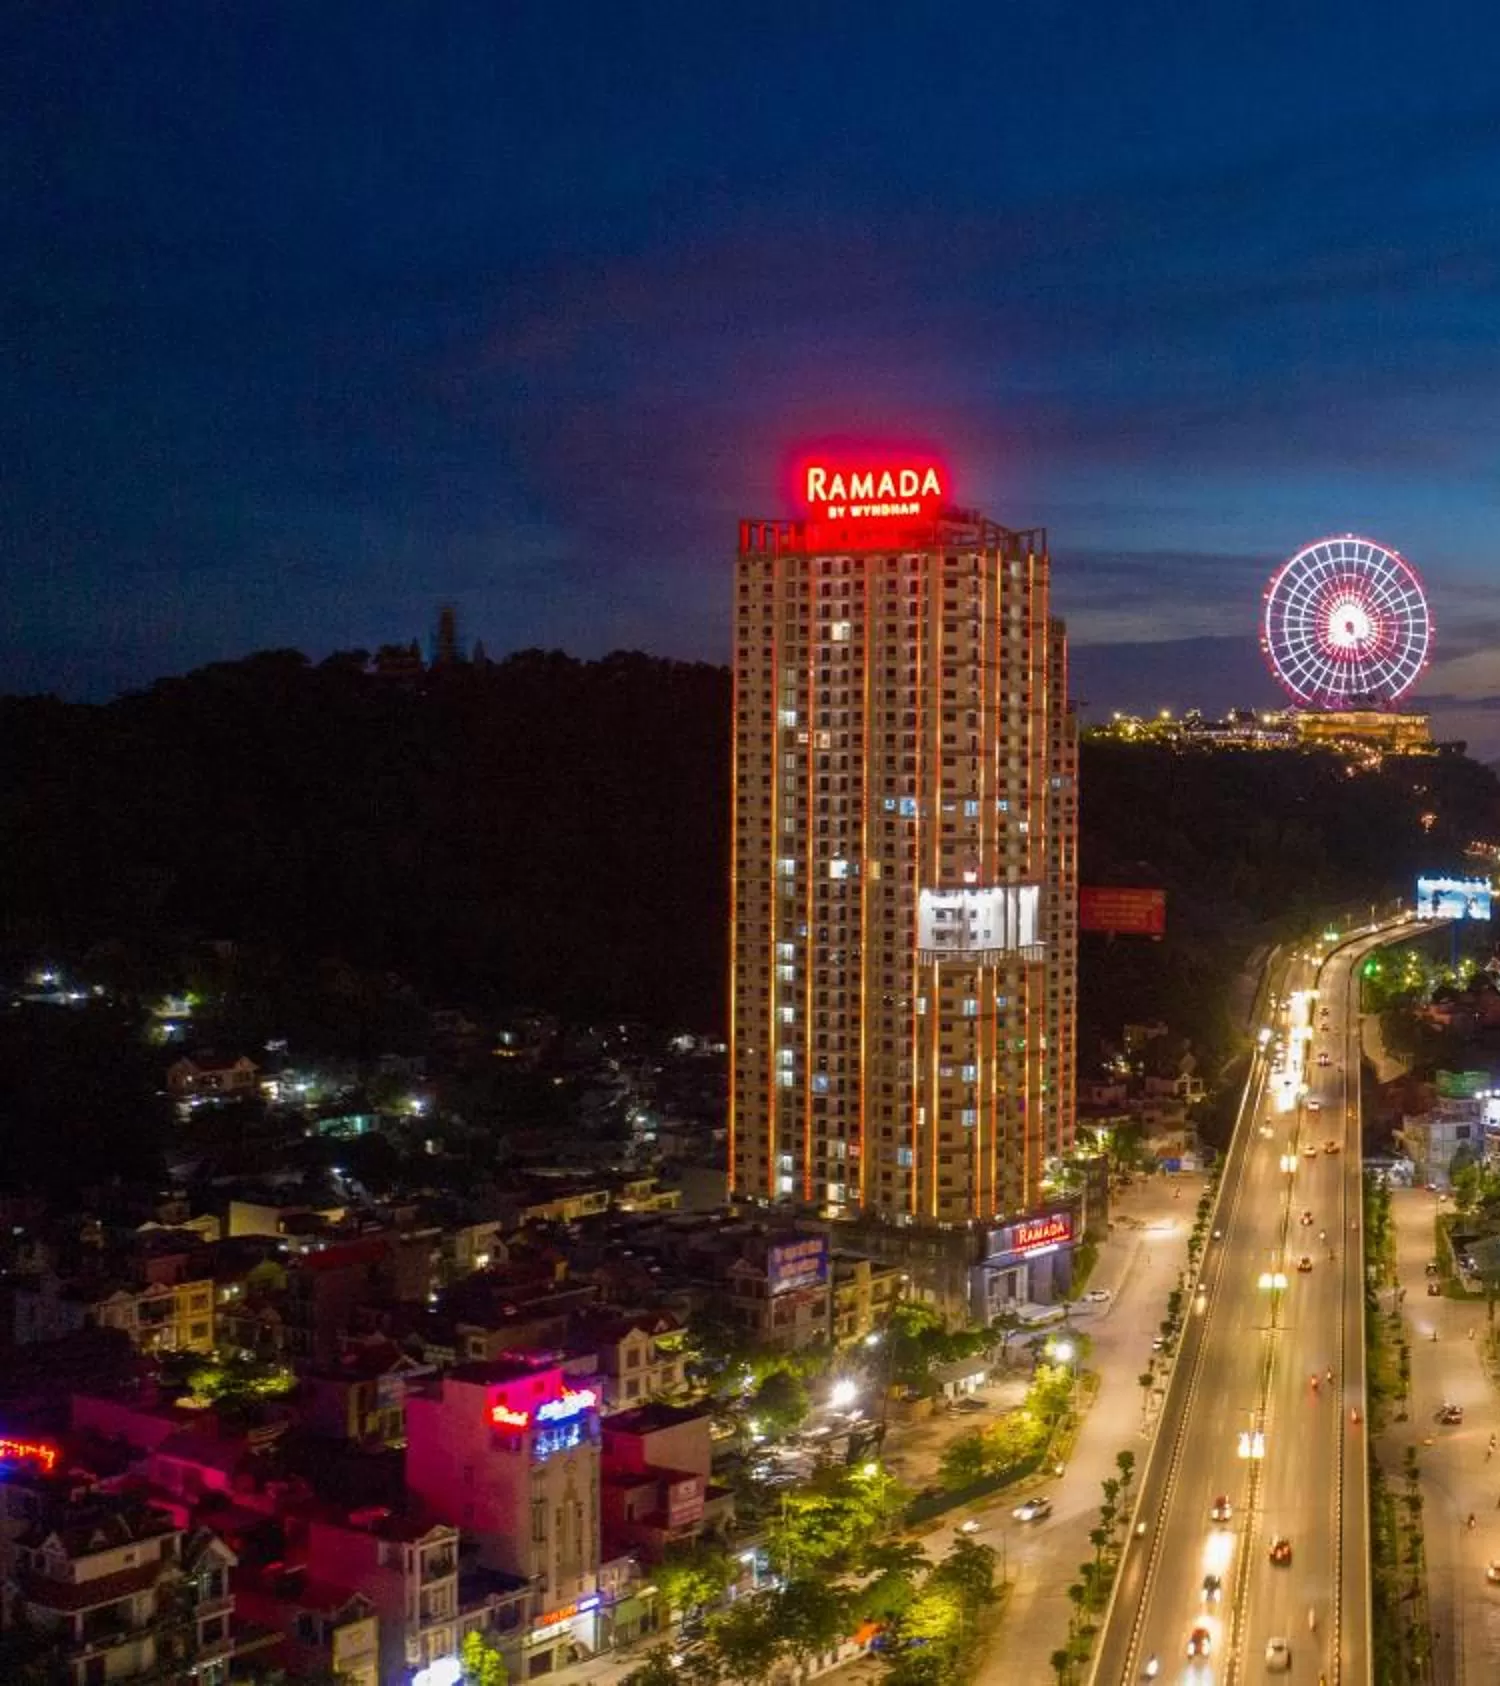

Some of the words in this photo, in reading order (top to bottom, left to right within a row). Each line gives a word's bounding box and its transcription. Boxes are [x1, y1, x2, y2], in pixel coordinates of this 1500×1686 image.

[807, 467, 941, 502] RAMADA
[828, 505, 846, 519] BY
[850, 502, 920, 517] WYNDHAM
[1018, 1222, 1065, 1245] RAMADA
